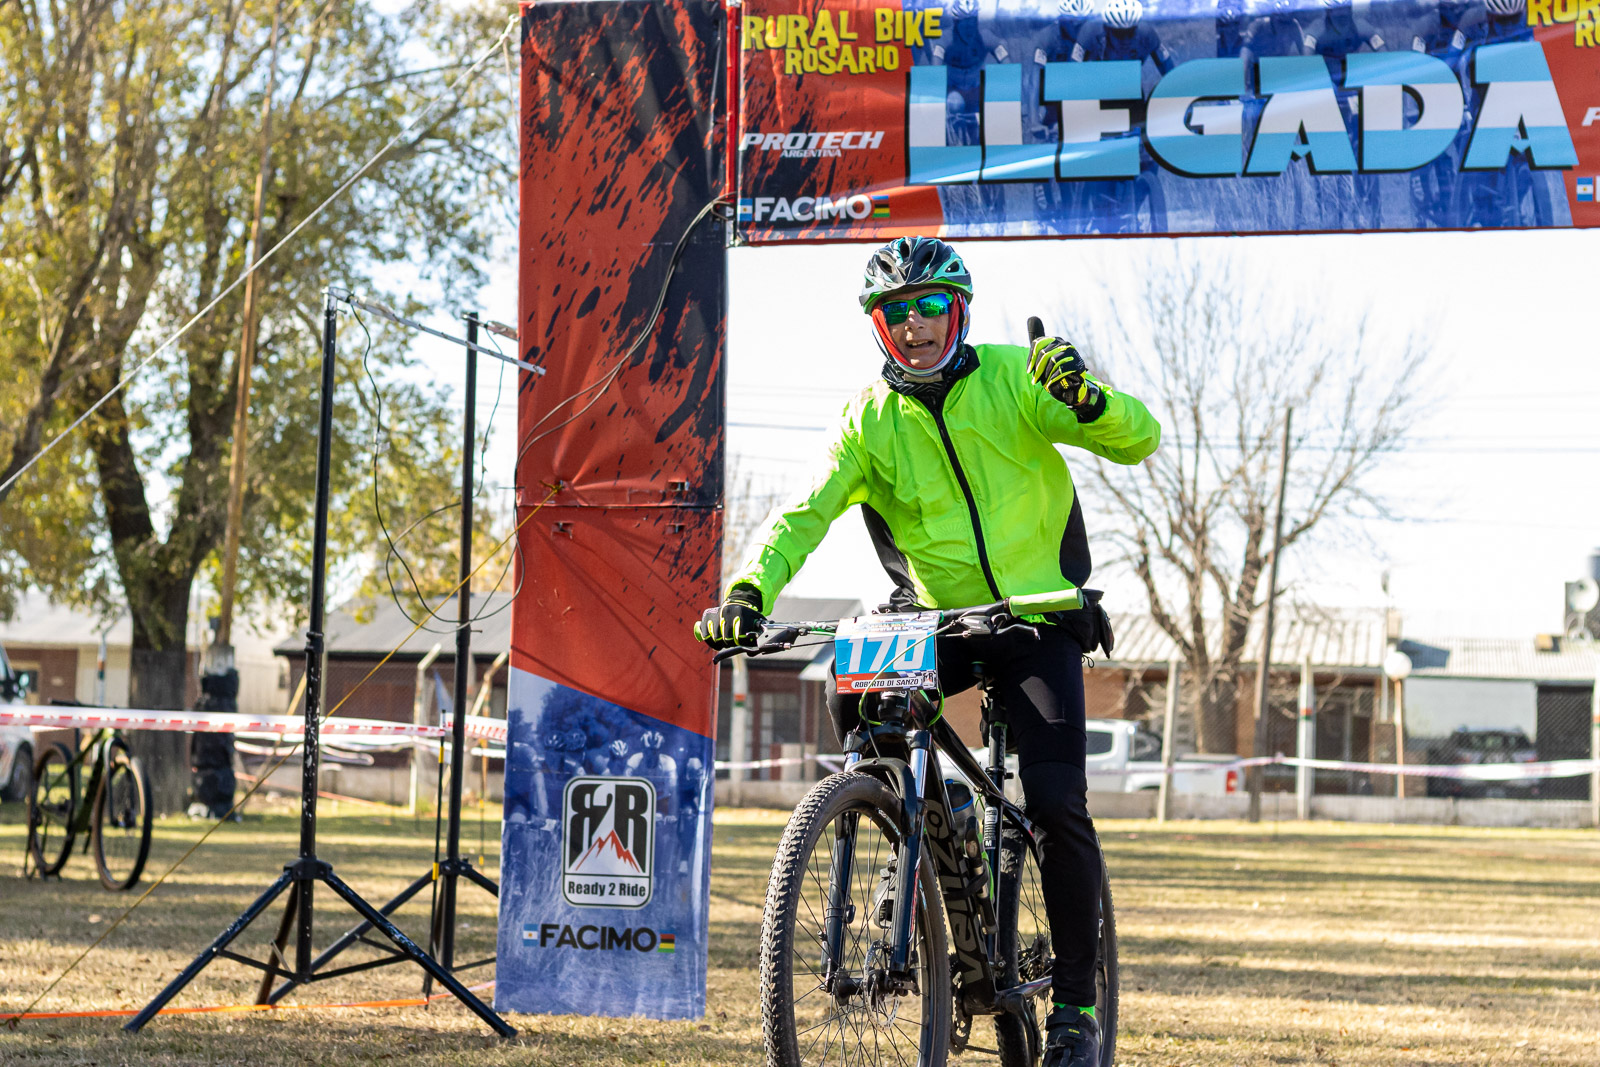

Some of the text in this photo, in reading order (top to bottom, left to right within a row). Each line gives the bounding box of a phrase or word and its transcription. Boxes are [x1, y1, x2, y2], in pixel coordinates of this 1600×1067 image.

[743, 7, 944, 50] RURAL BIKE
[785, 45, 899, 76] ROSARIO
[906, 41, 1580, 185] LLEGADA
[739, 131, 885, 151] PROTECH
[780, 148, 842, 158] ARGENTINA
[754, 194, 872, 222] FACIMO
[847, 631, 928, 674] 170
[854, 680, 885, 688] ROBRTO
[895, 678, 919, 686] SANZO
[568, 881, 646, 897] Ready 2 Ride
[540, 924, 657, 953] FACIMO
